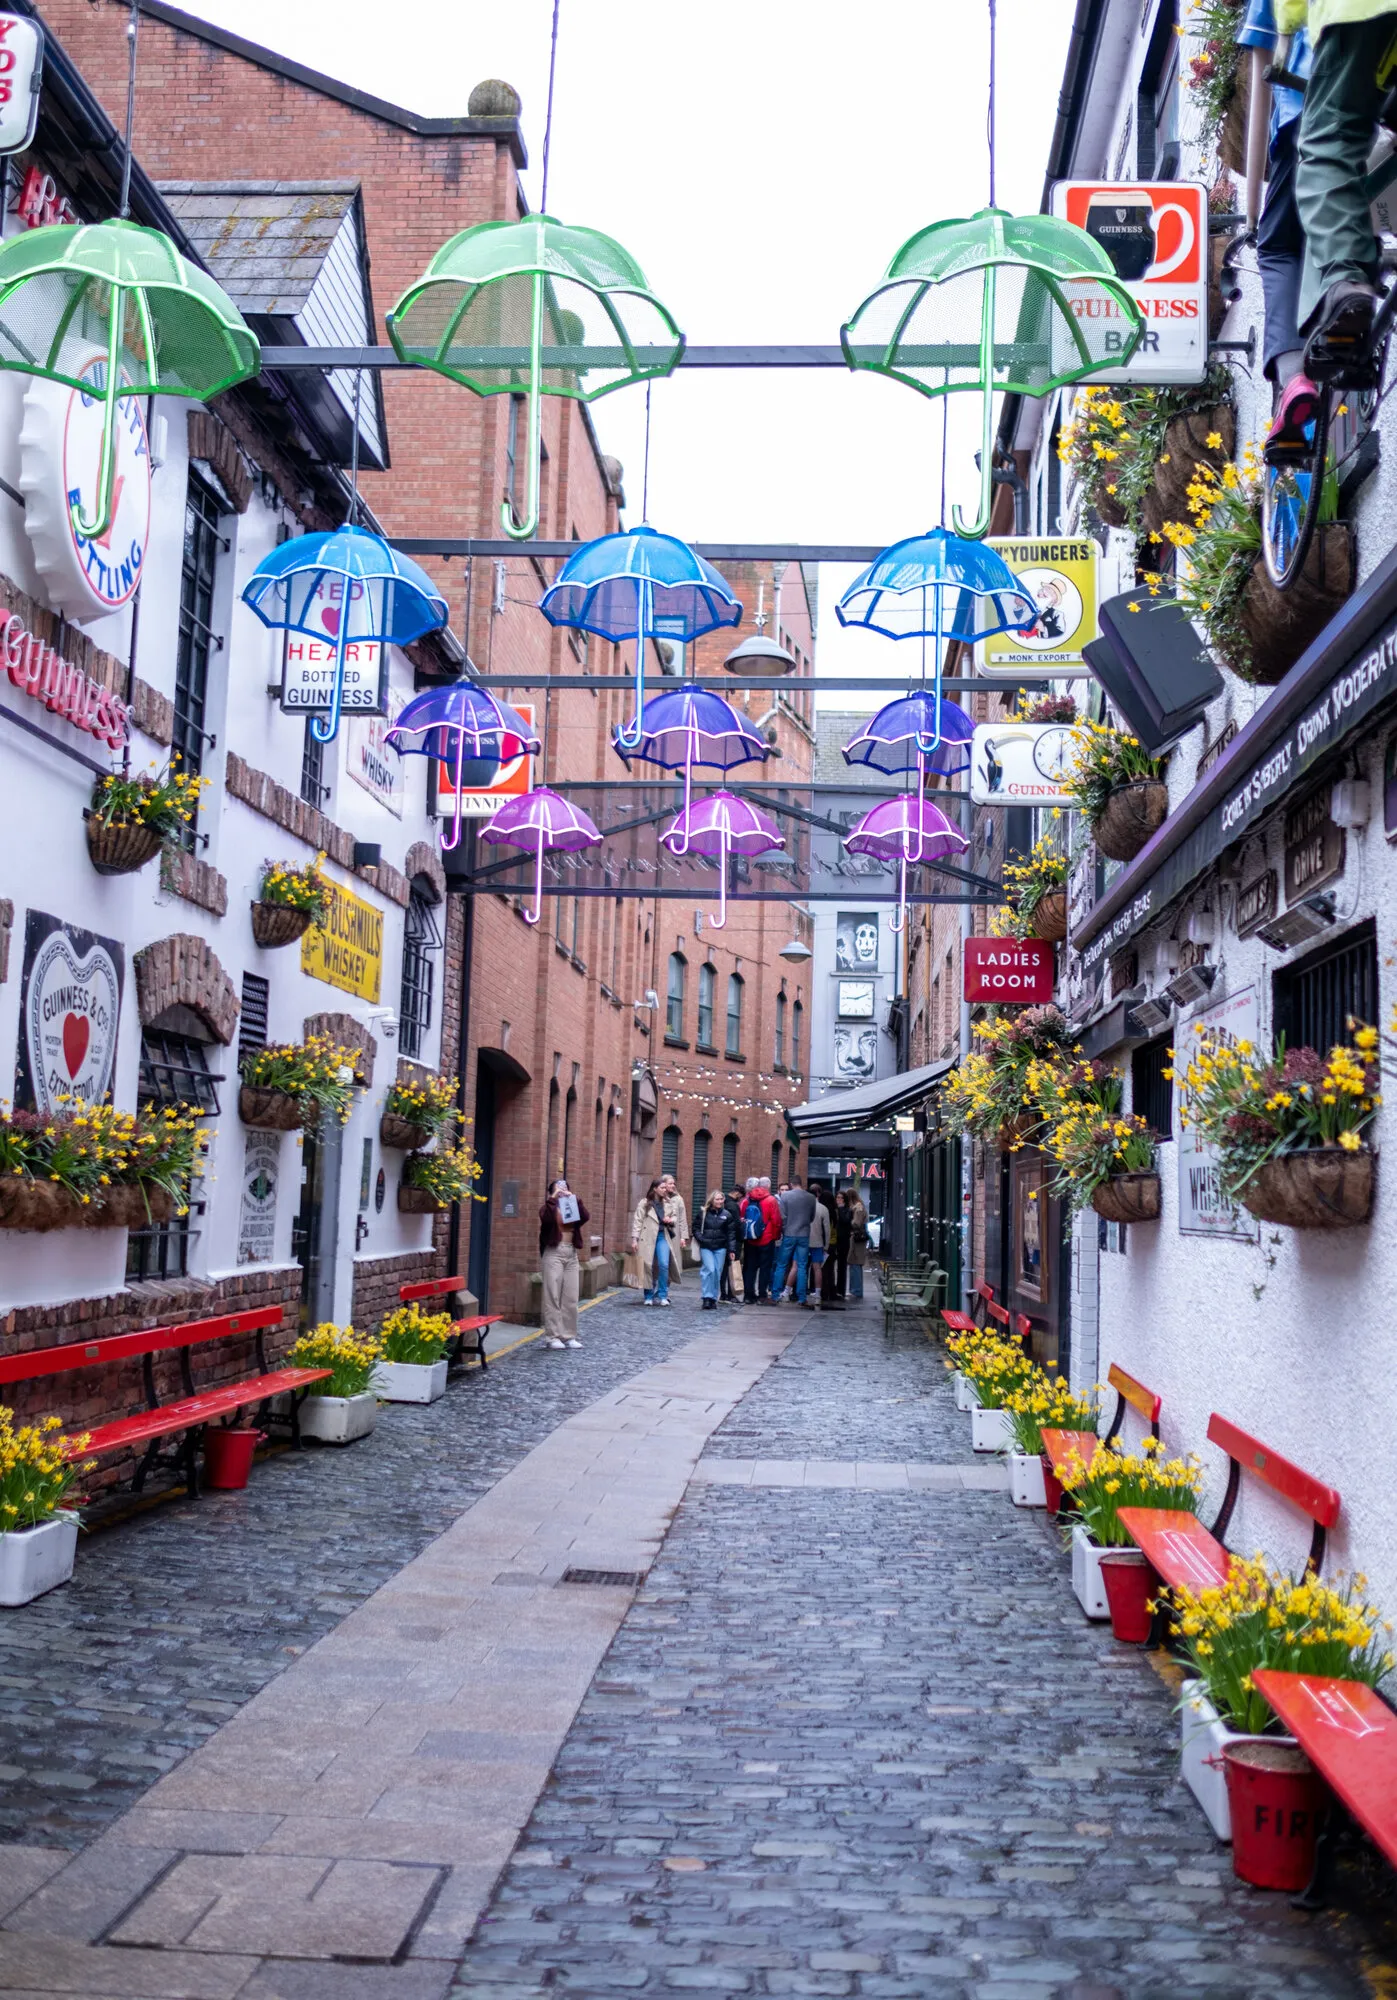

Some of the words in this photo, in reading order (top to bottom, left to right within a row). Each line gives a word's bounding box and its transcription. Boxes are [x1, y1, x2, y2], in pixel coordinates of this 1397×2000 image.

[1099, 225, 1143, 233] GUINNESS
[1068, 299, 1199, 320] GUINESS
[81, 361, 149, 456] QULITY
[1010, 543, 1090, 562] YOUNGER'S
[310, 582, 364, 601] RED
[288, 643, 379, 662] HEART
[1008, 654, 1034, 662] MONK
[1037, 653, 1071, 662] EXPORT
[0, 608, 136, 750] GUINNESS
[302, 670, 360, 683] BOTTED
[287, 688, 374, 705] GUINESS
[1297, 697, 1331, 756] DRINK
[1331, 631, 1397, 720] MODERAT
[361, 743, 395, 797] WHISKY
[330, 887, 382, 959] BUSHMILLS
[322, 935, 367, 986] WHISKEY
[977, 952, 1041, 966] LADIES
[981, 974, 1036, 988] ROOM
[43, 985, 89, 1023] GUINNESS
